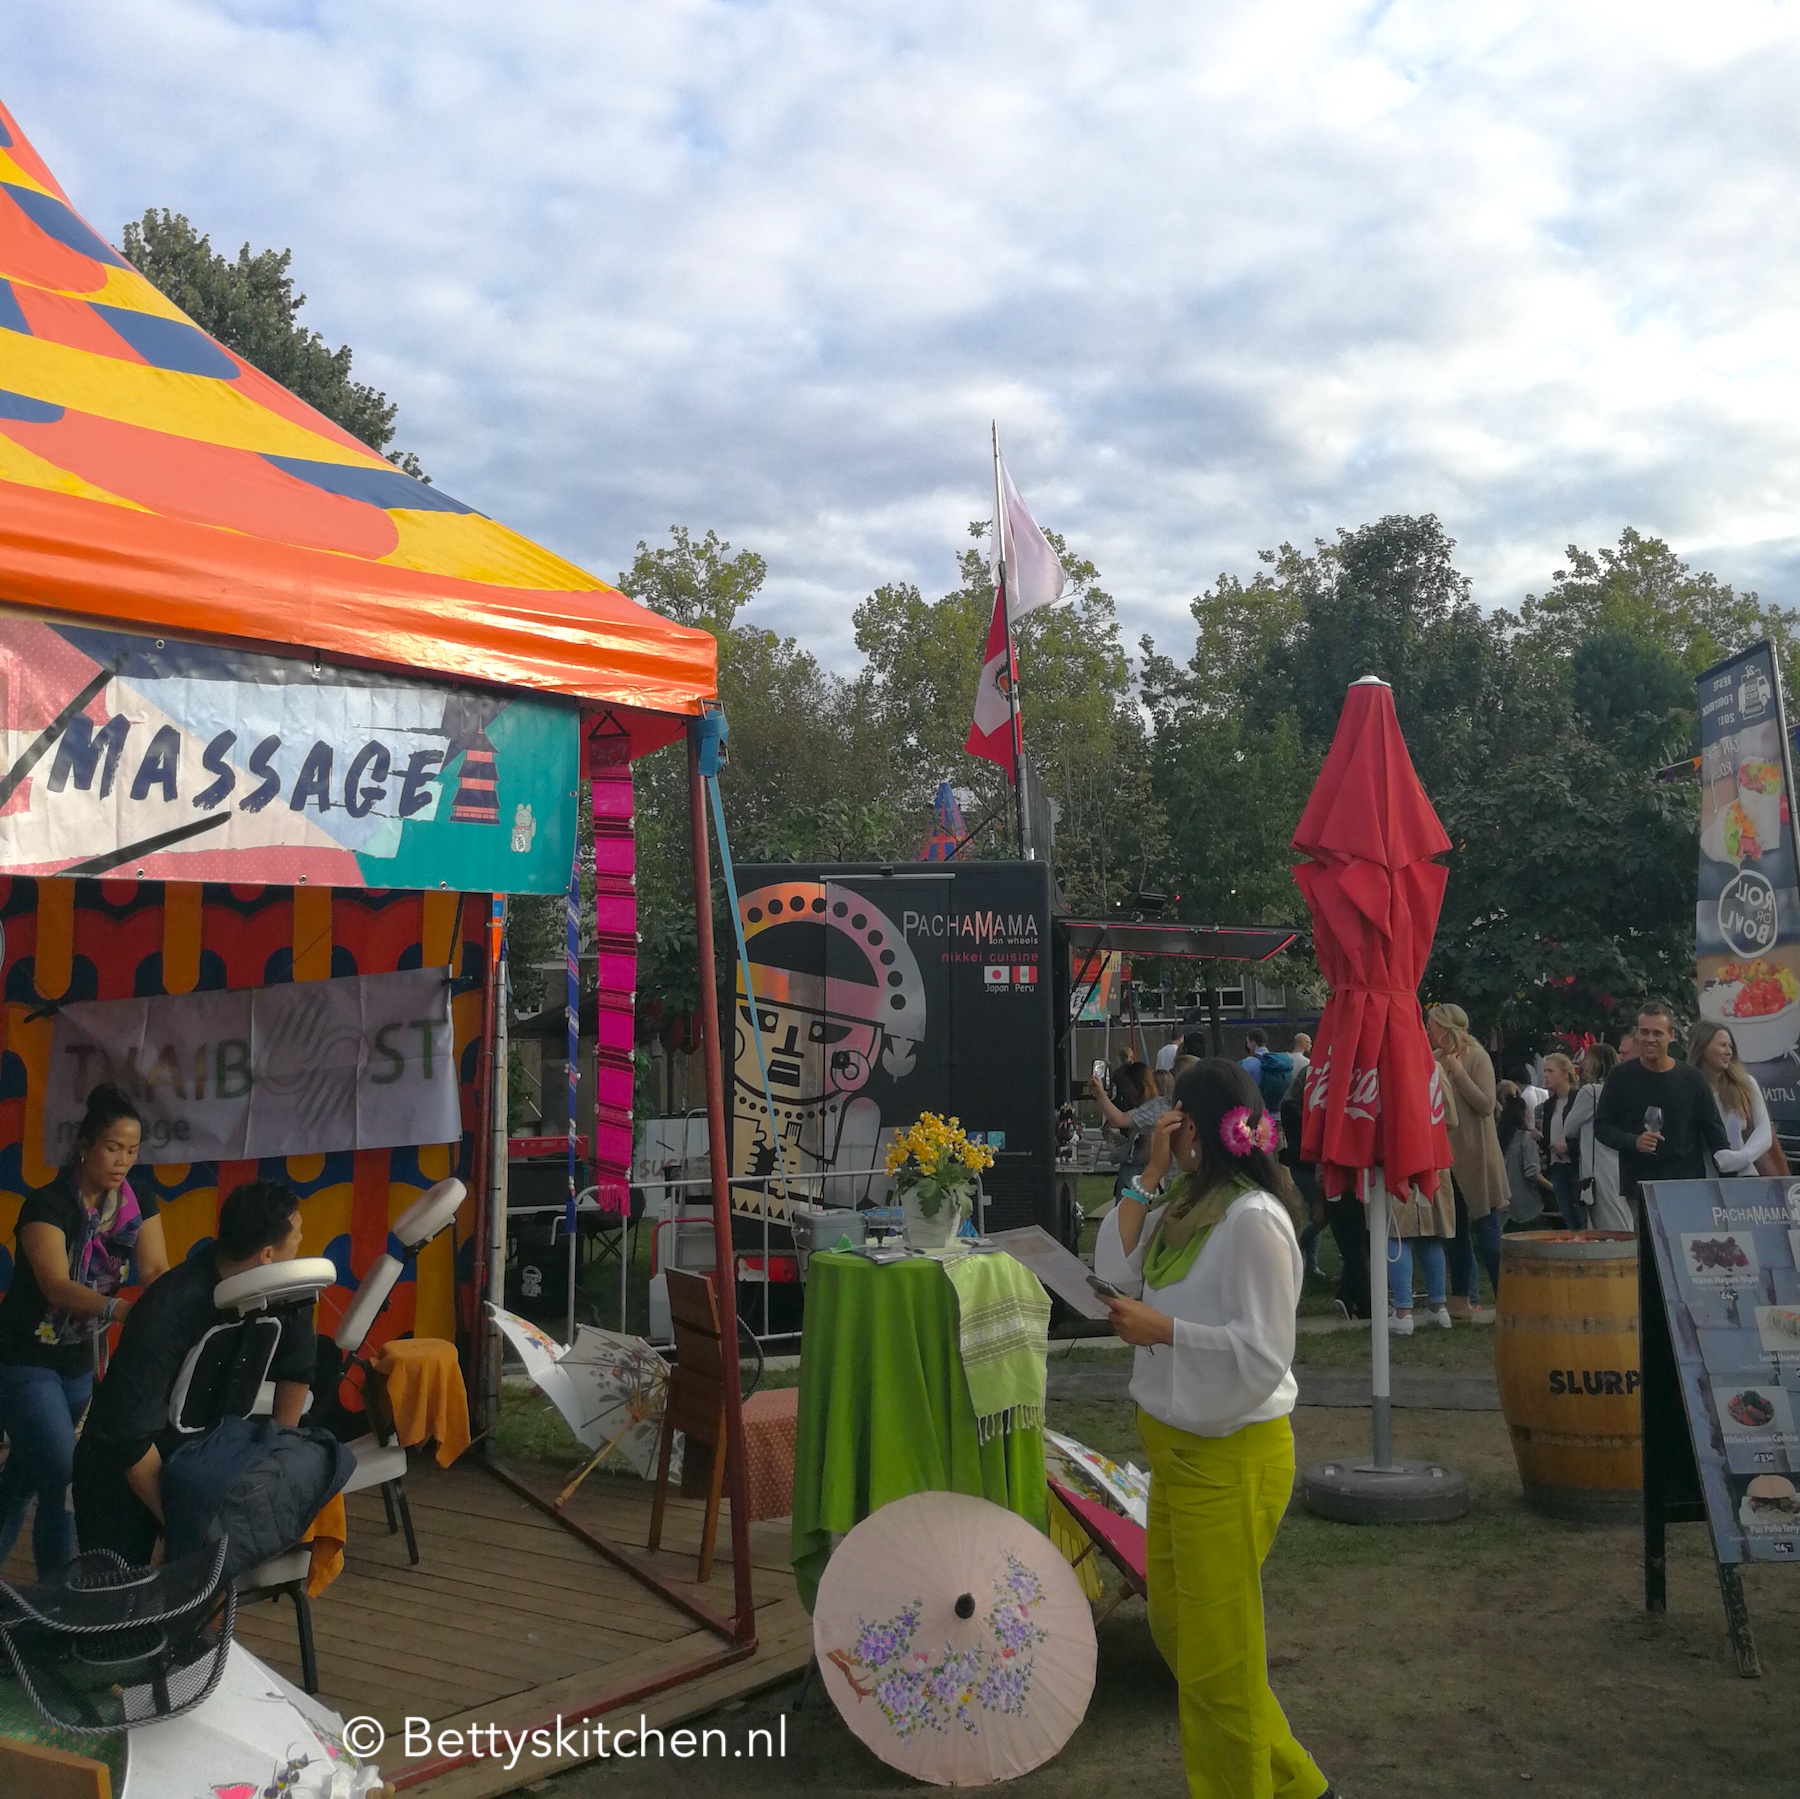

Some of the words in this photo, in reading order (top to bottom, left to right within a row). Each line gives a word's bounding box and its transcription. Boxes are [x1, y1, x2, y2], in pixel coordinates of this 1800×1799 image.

[47, 712, 446, 819] MASSAGE
[1007, 936, 1038, 945] wheels
[941, 951, 983, 963] nikkei
[989, 952, 1039, 963] cuisine
[984, 984, 1009, 994] Japan
[1014, 983, 1035, 993] Peru
[1549, 1369, 1641, 1395] SLURP
